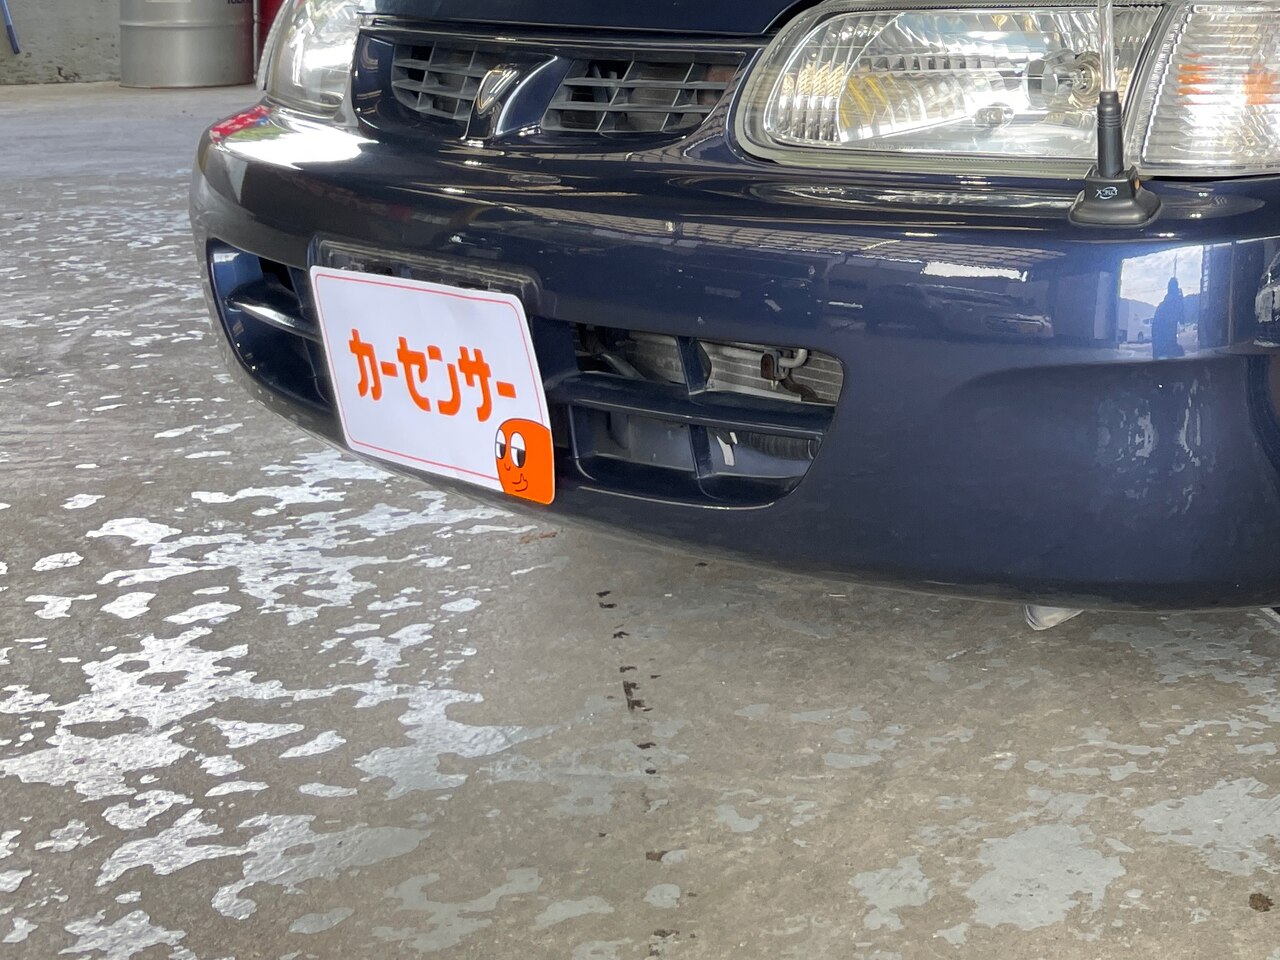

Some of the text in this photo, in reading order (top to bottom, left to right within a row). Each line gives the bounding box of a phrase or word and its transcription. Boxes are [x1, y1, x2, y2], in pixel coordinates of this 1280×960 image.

[348, 328, 517, 422] カーセンサー
